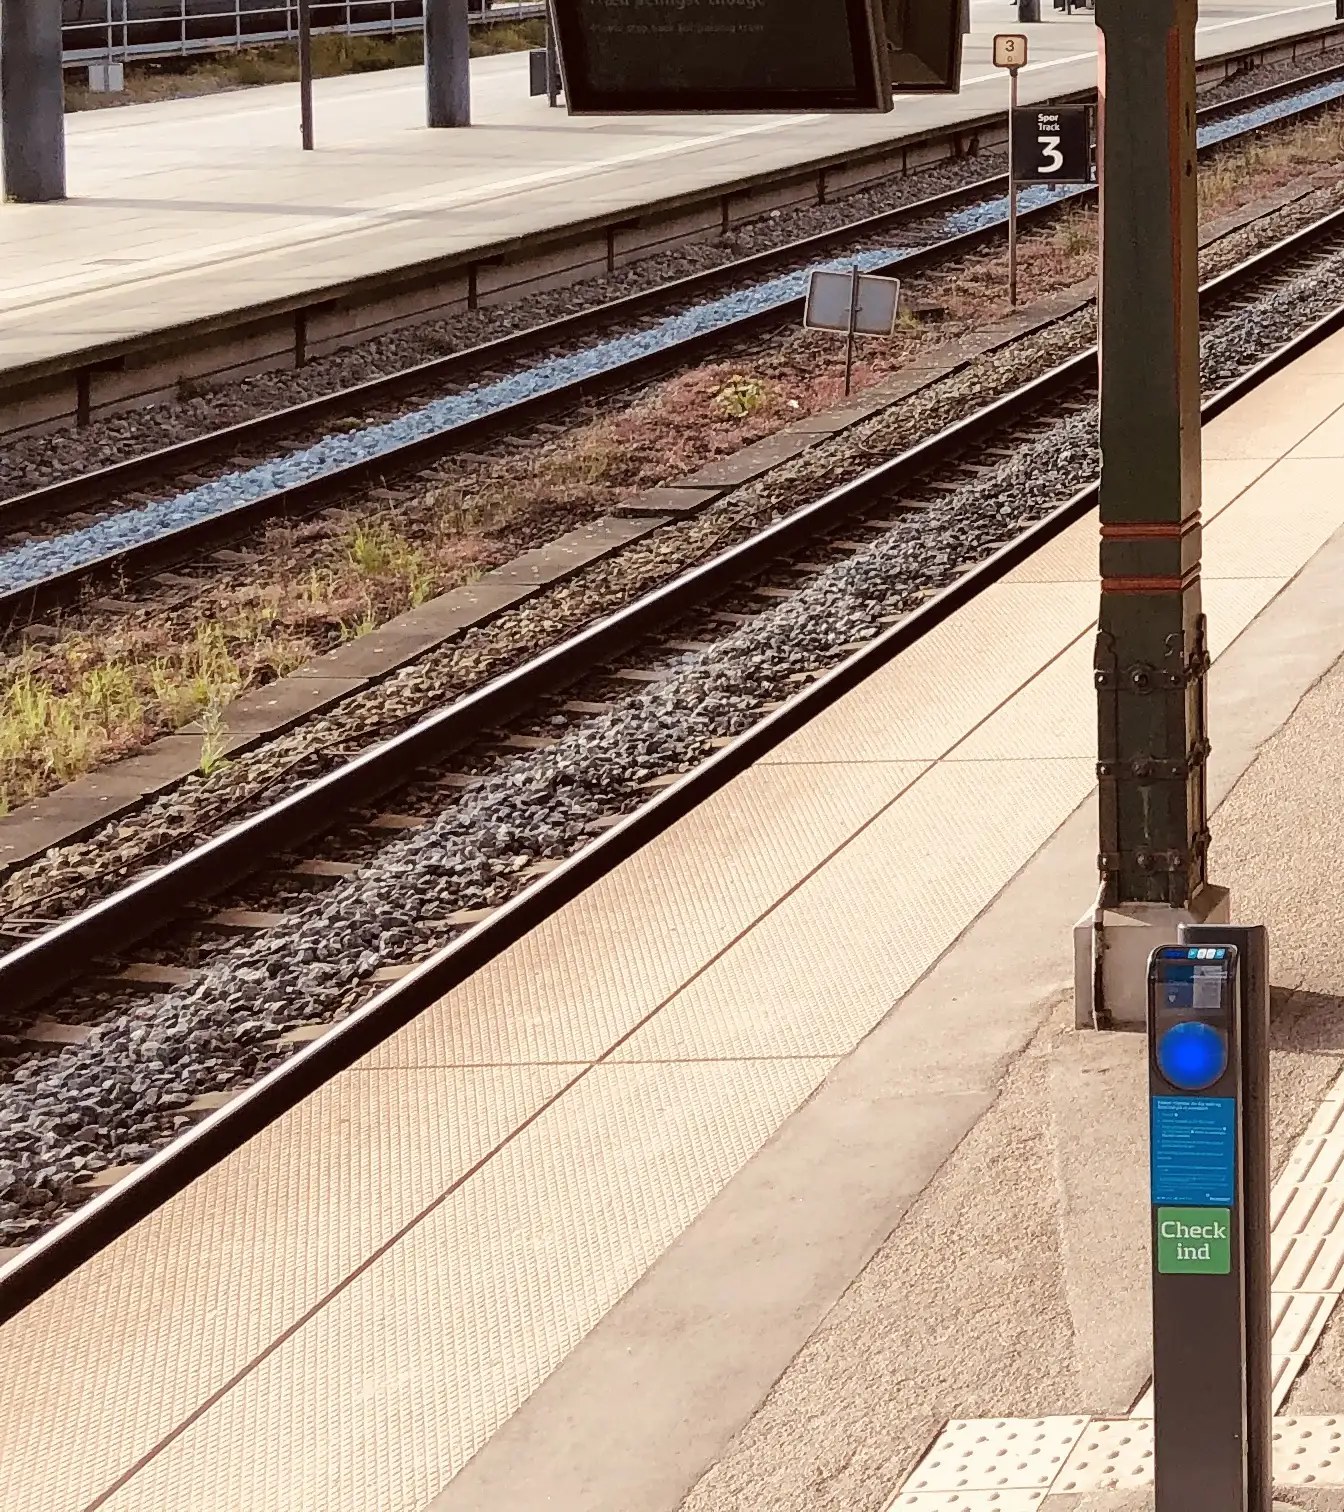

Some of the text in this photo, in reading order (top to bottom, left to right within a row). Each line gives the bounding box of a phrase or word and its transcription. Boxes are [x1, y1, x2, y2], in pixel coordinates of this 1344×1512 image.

[1005, 39, 1015, 52] 3
[1037, 114, 1059, 123] Spor
[1037, 123, 1060, 131] Track
[1037, 135, 1064, 173] 3
[1160, 1221, 1227, 1240] Check
[1176, 1241, 1211, 1261] ind
